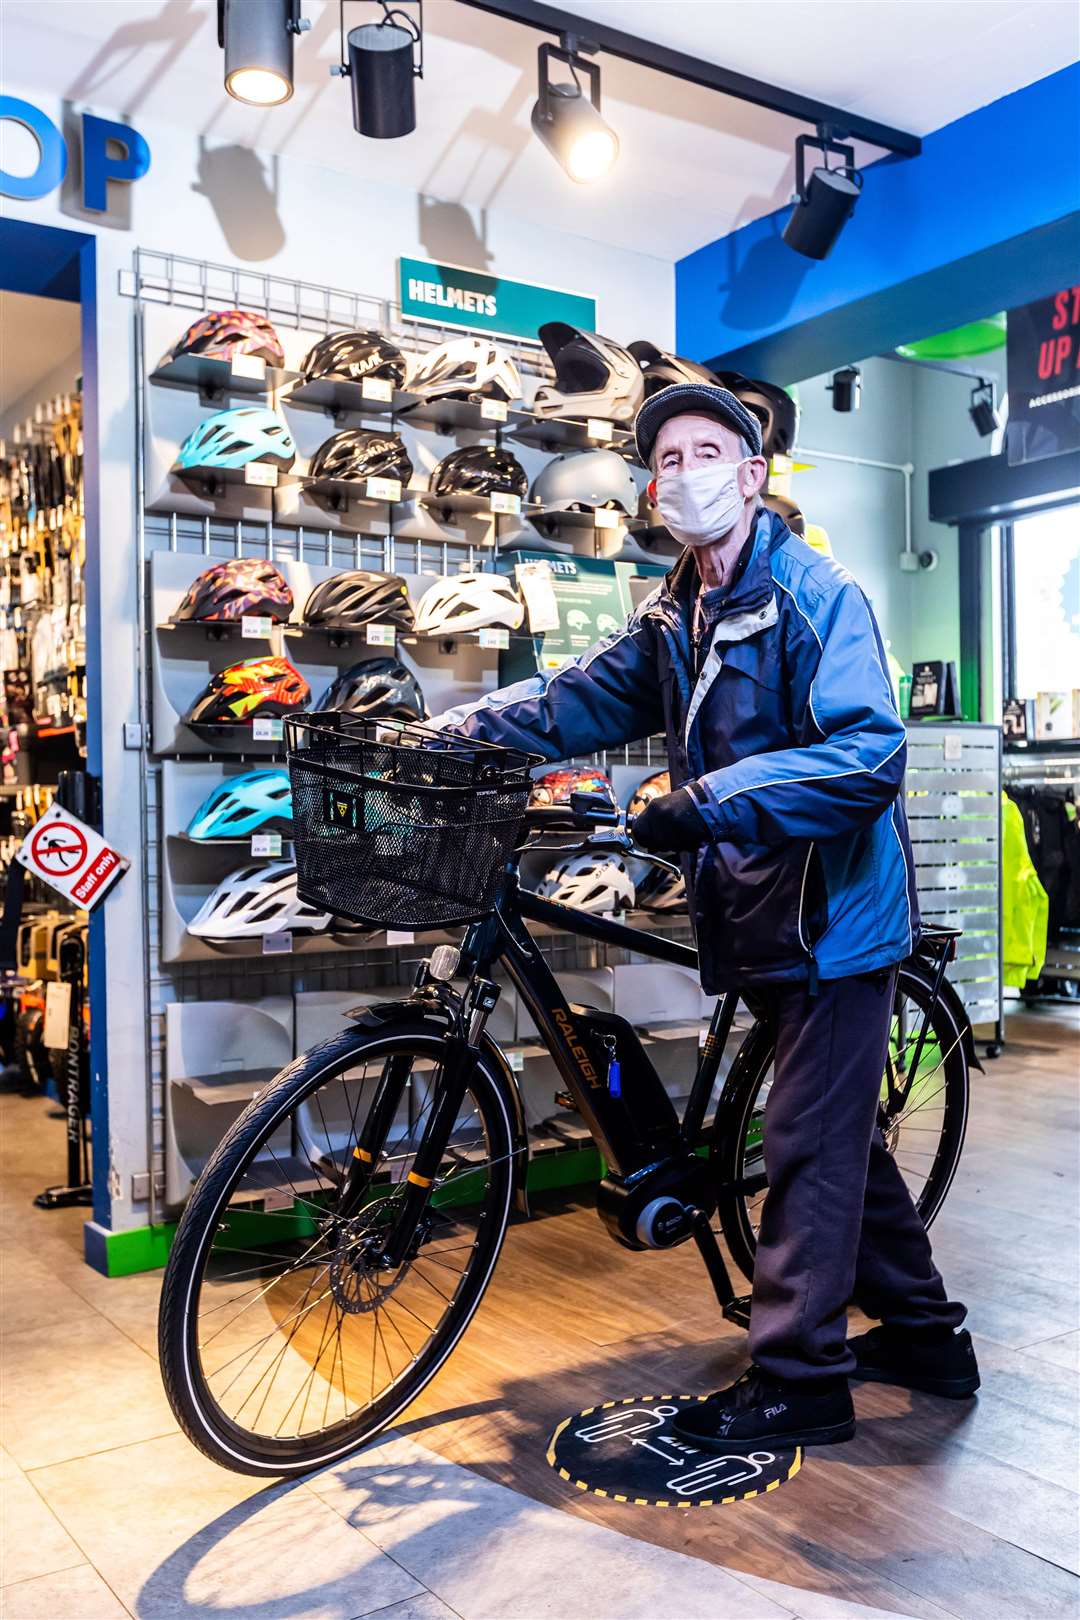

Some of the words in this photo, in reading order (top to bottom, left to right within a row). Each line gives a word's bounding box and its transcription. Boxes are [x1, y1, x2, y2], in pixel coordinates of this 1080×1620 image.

[408, 278, 497, 316] HELMETS
[349, 353, 384, 377] KASK
[1038, 335, 1072, 380] UP
[75, 872, 98, 899] Staff
[95, 851, 116, 876] only
[552, 1008, 602, 1089] RALEIGH
[67, 1025, 81, 1144] BONTRAGER
[764, 1403, 788, 1419] FILA
